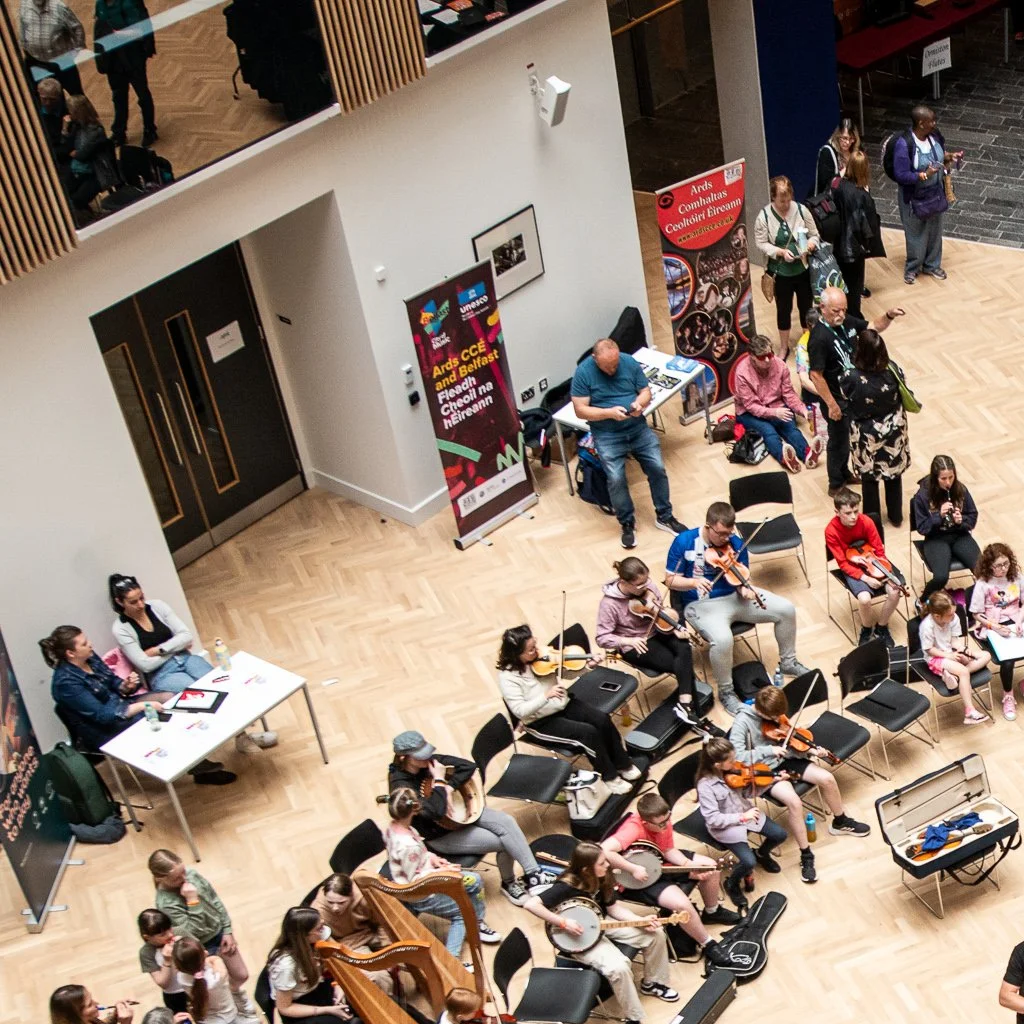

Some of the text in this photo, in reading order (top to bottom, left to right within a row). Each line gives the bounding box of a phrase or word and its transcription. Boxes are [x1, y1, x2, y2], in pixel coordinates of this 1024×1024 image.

[678, 190, 728, 215] Comhaltas
[691, 180, 713, 196] Ards
[460, 295, 489, 314] unesco
[432, 338, 486, 378] Ards CCÉ
[435, 349, 499, 392] and Belfast
[437, 375, 477, 405] Fleadh
[440, 381, 494, 416] Cheoil na
